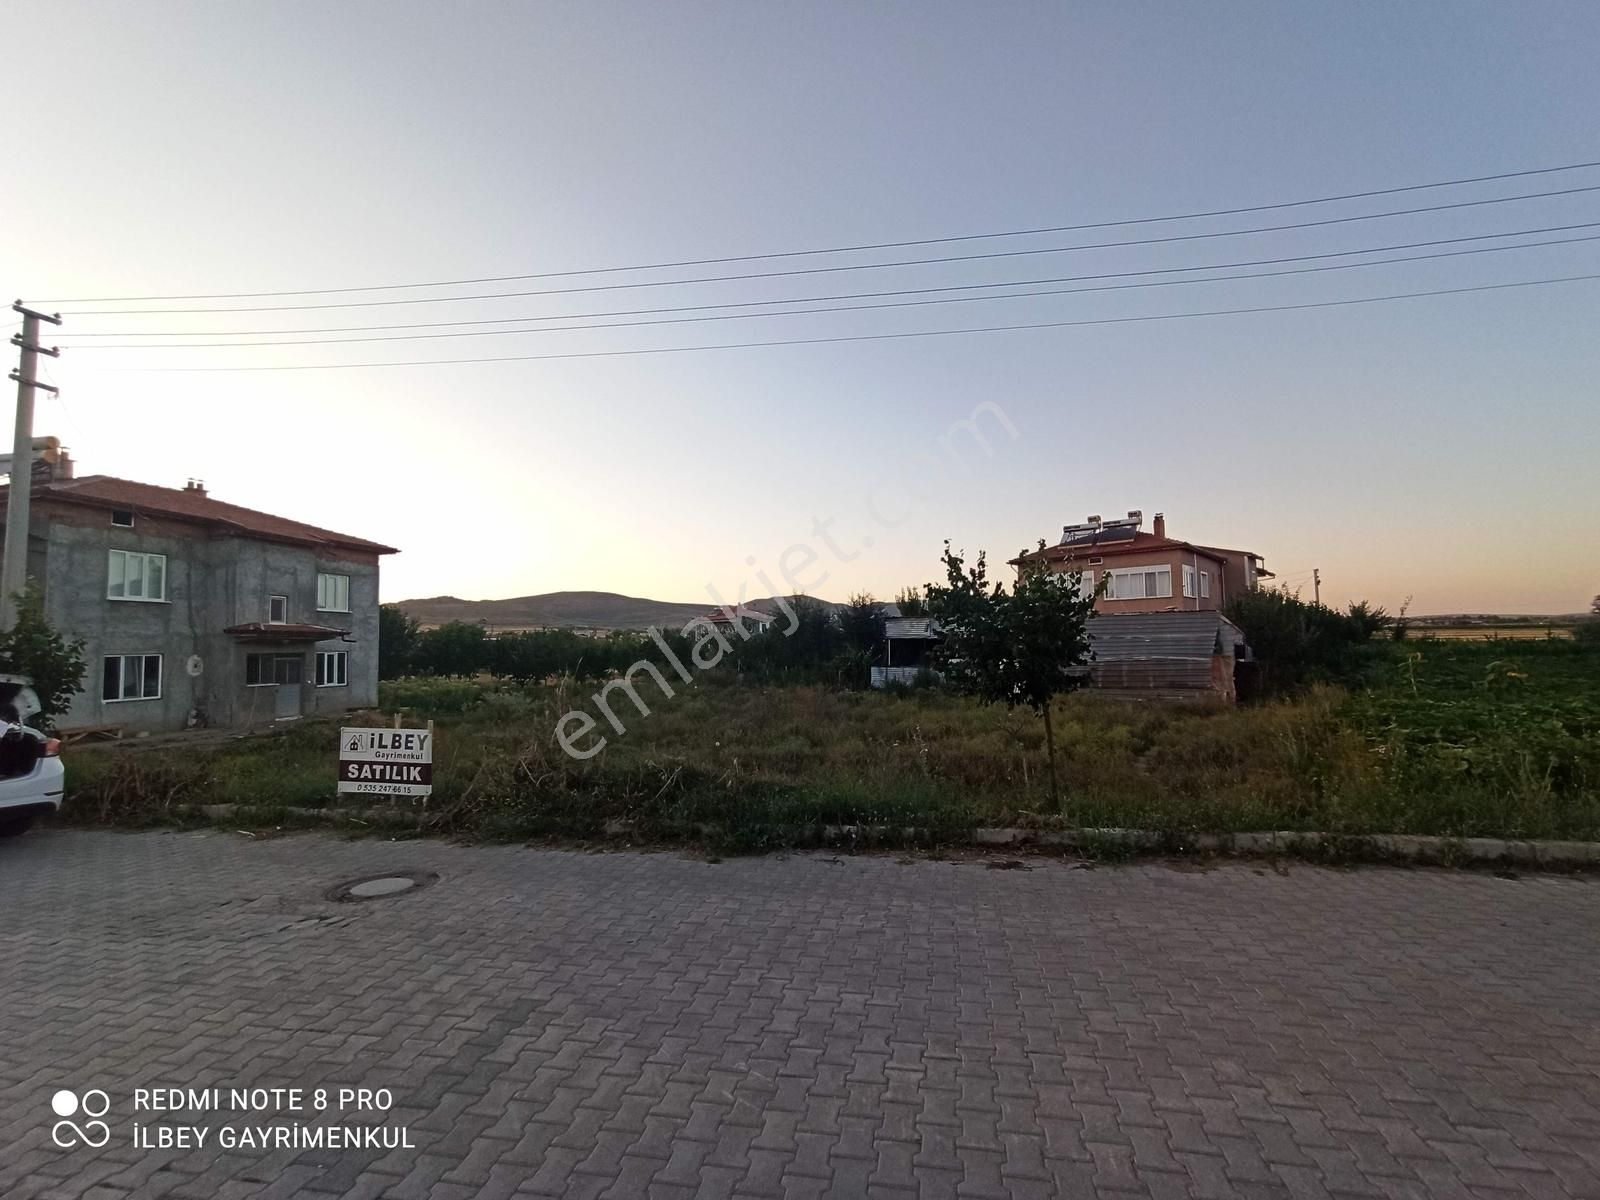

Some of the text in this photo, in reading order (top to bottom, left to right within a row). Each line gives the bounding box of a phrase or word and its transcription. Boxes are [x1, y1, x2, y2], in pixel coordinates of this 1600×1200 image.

[375, 751, 423, 760] Gayrimenkul
[348, 764, 422, 781] SATILIK
[363, 784, 377, 792] 535
[403, 786, 412, 794] 15
